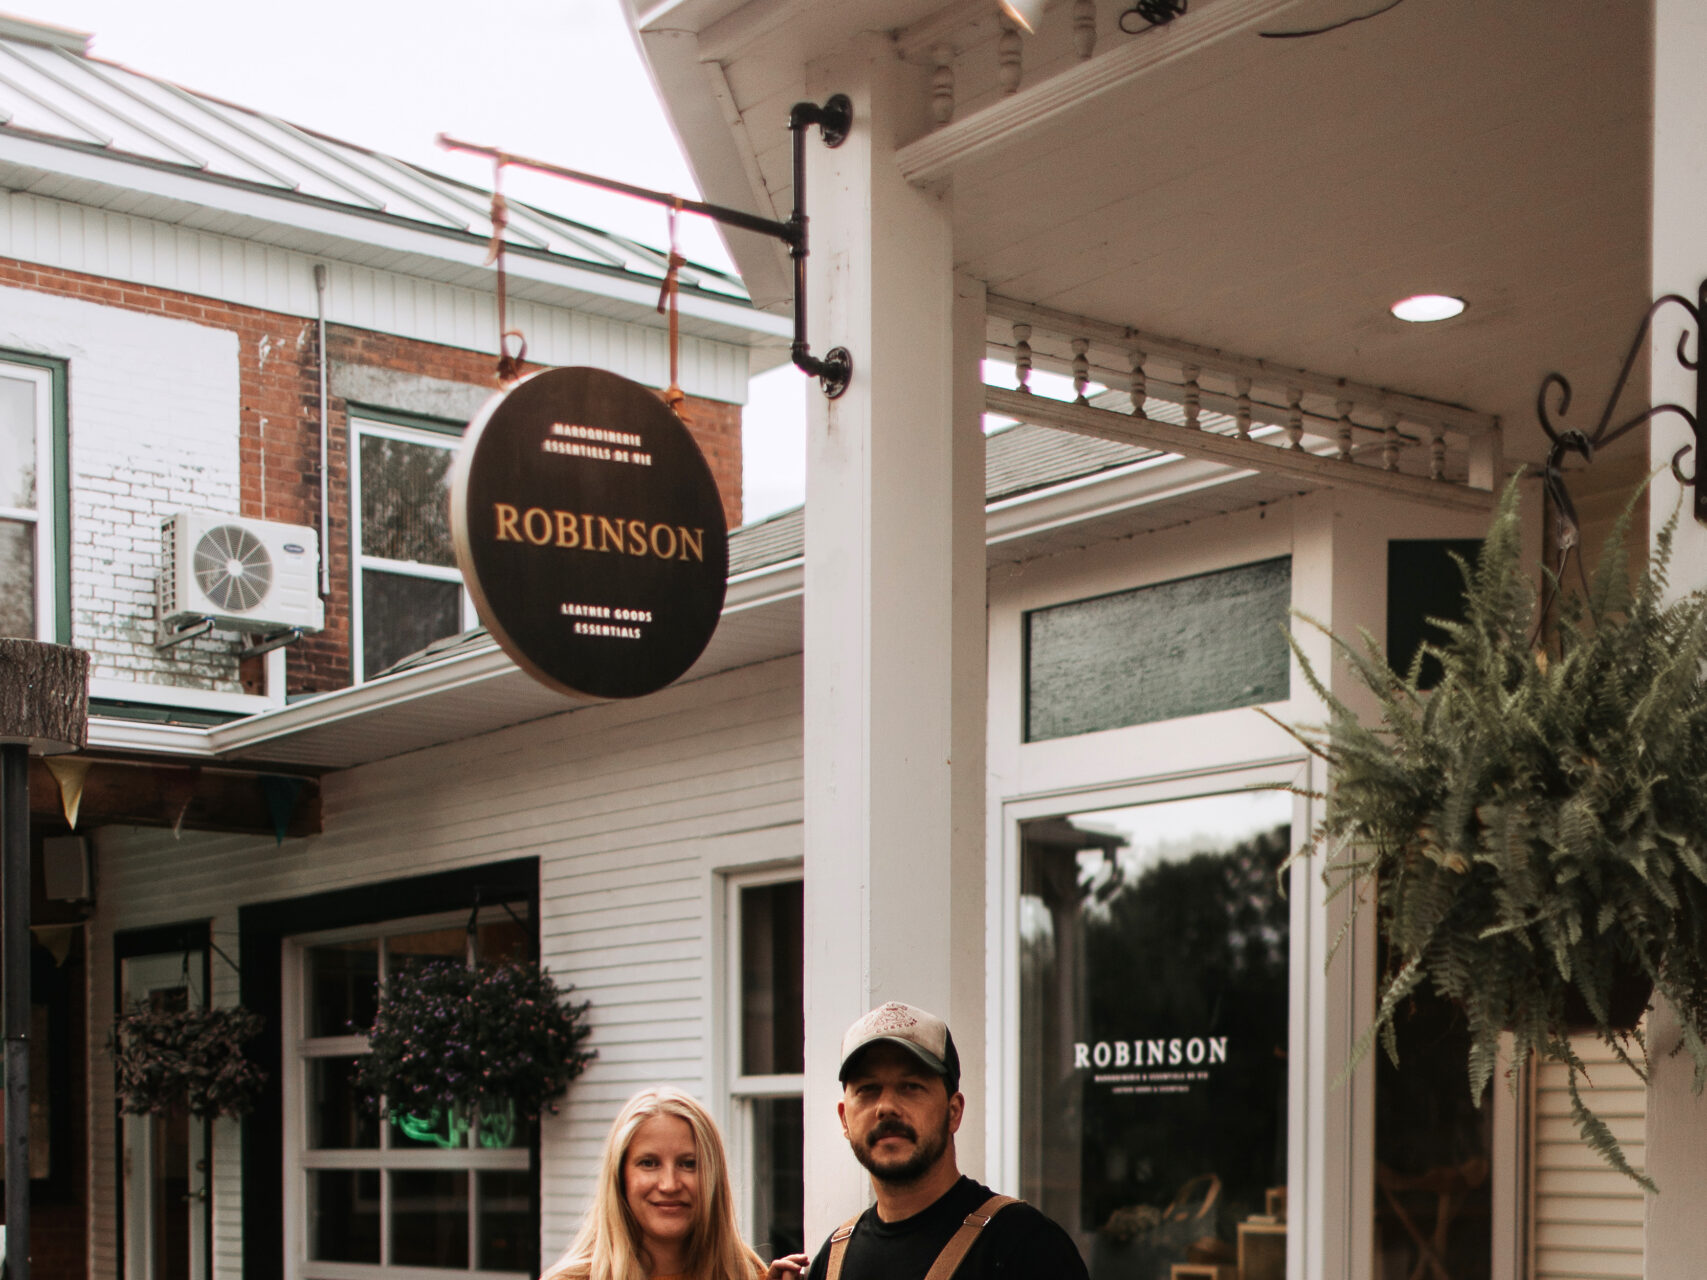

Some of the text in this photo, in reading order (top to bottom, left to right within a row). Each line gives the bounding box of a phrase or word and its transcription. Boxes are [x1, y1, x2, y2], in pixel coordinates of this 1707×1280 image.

[613, 449, 629, 463] DE
[632, 452, 652, 466] VIE
[494, 503, 704, 562] ROBINSON
[561, 602, 652, 622] LEATHER GOODS
[574, 622, 641, 639] ESSENTIALS
[1074, 1036, 1228, 1068] ROBINSON
